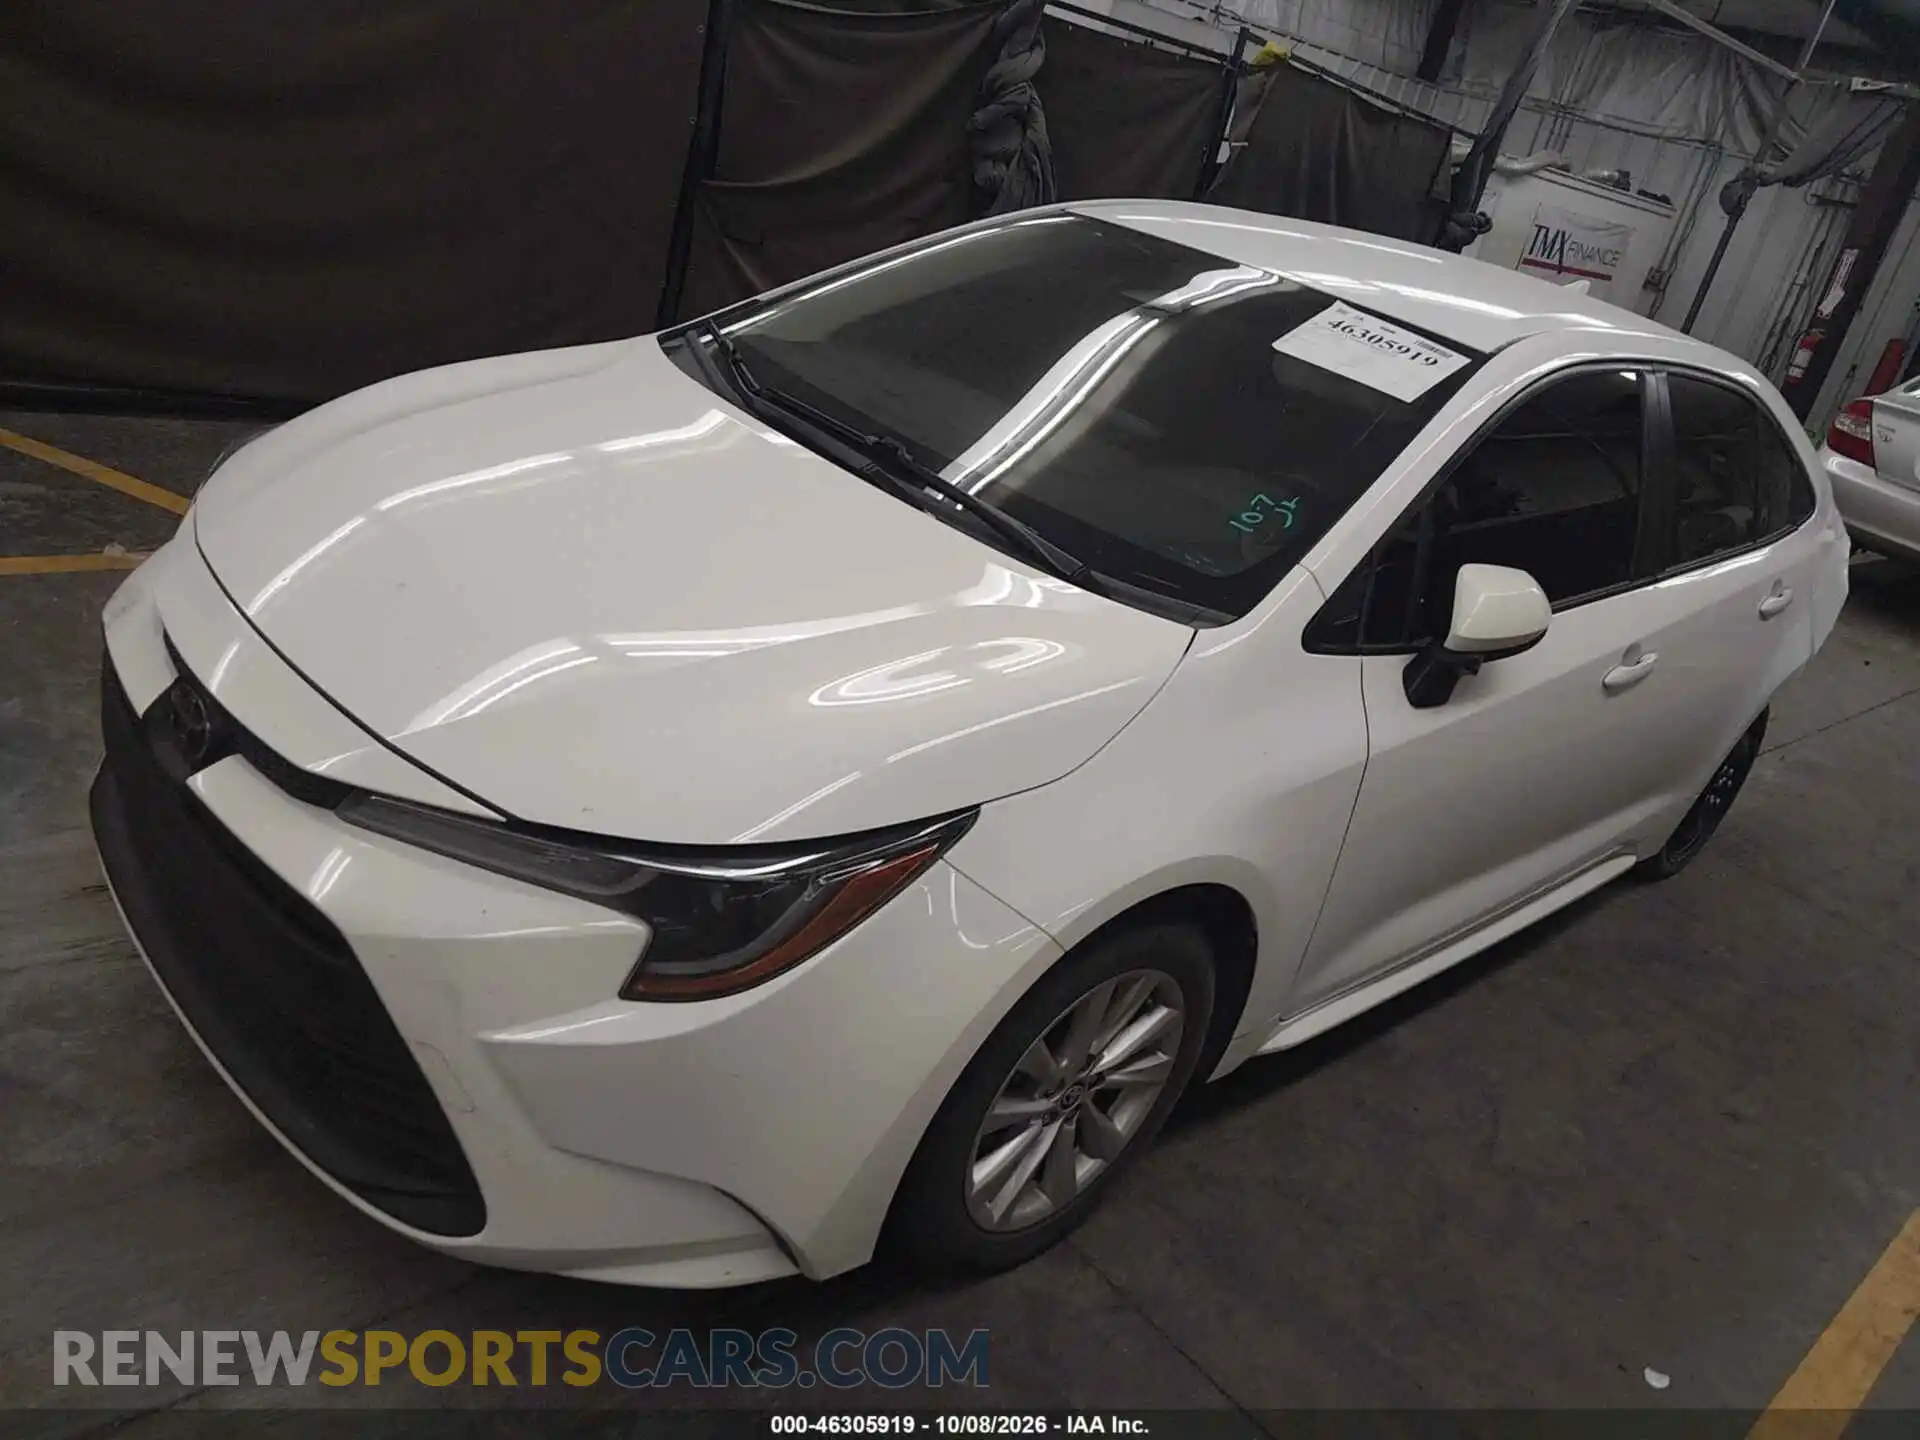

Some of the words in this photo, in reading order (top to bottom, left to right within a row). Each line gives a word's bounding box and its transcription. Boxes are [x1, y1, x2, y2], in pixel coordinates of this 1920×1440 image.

[1528, 224, 1572, 275] TMX
[1567, 240, 1621, 268] FINANCE
[1328, 318, 1439, 367] 46305919
